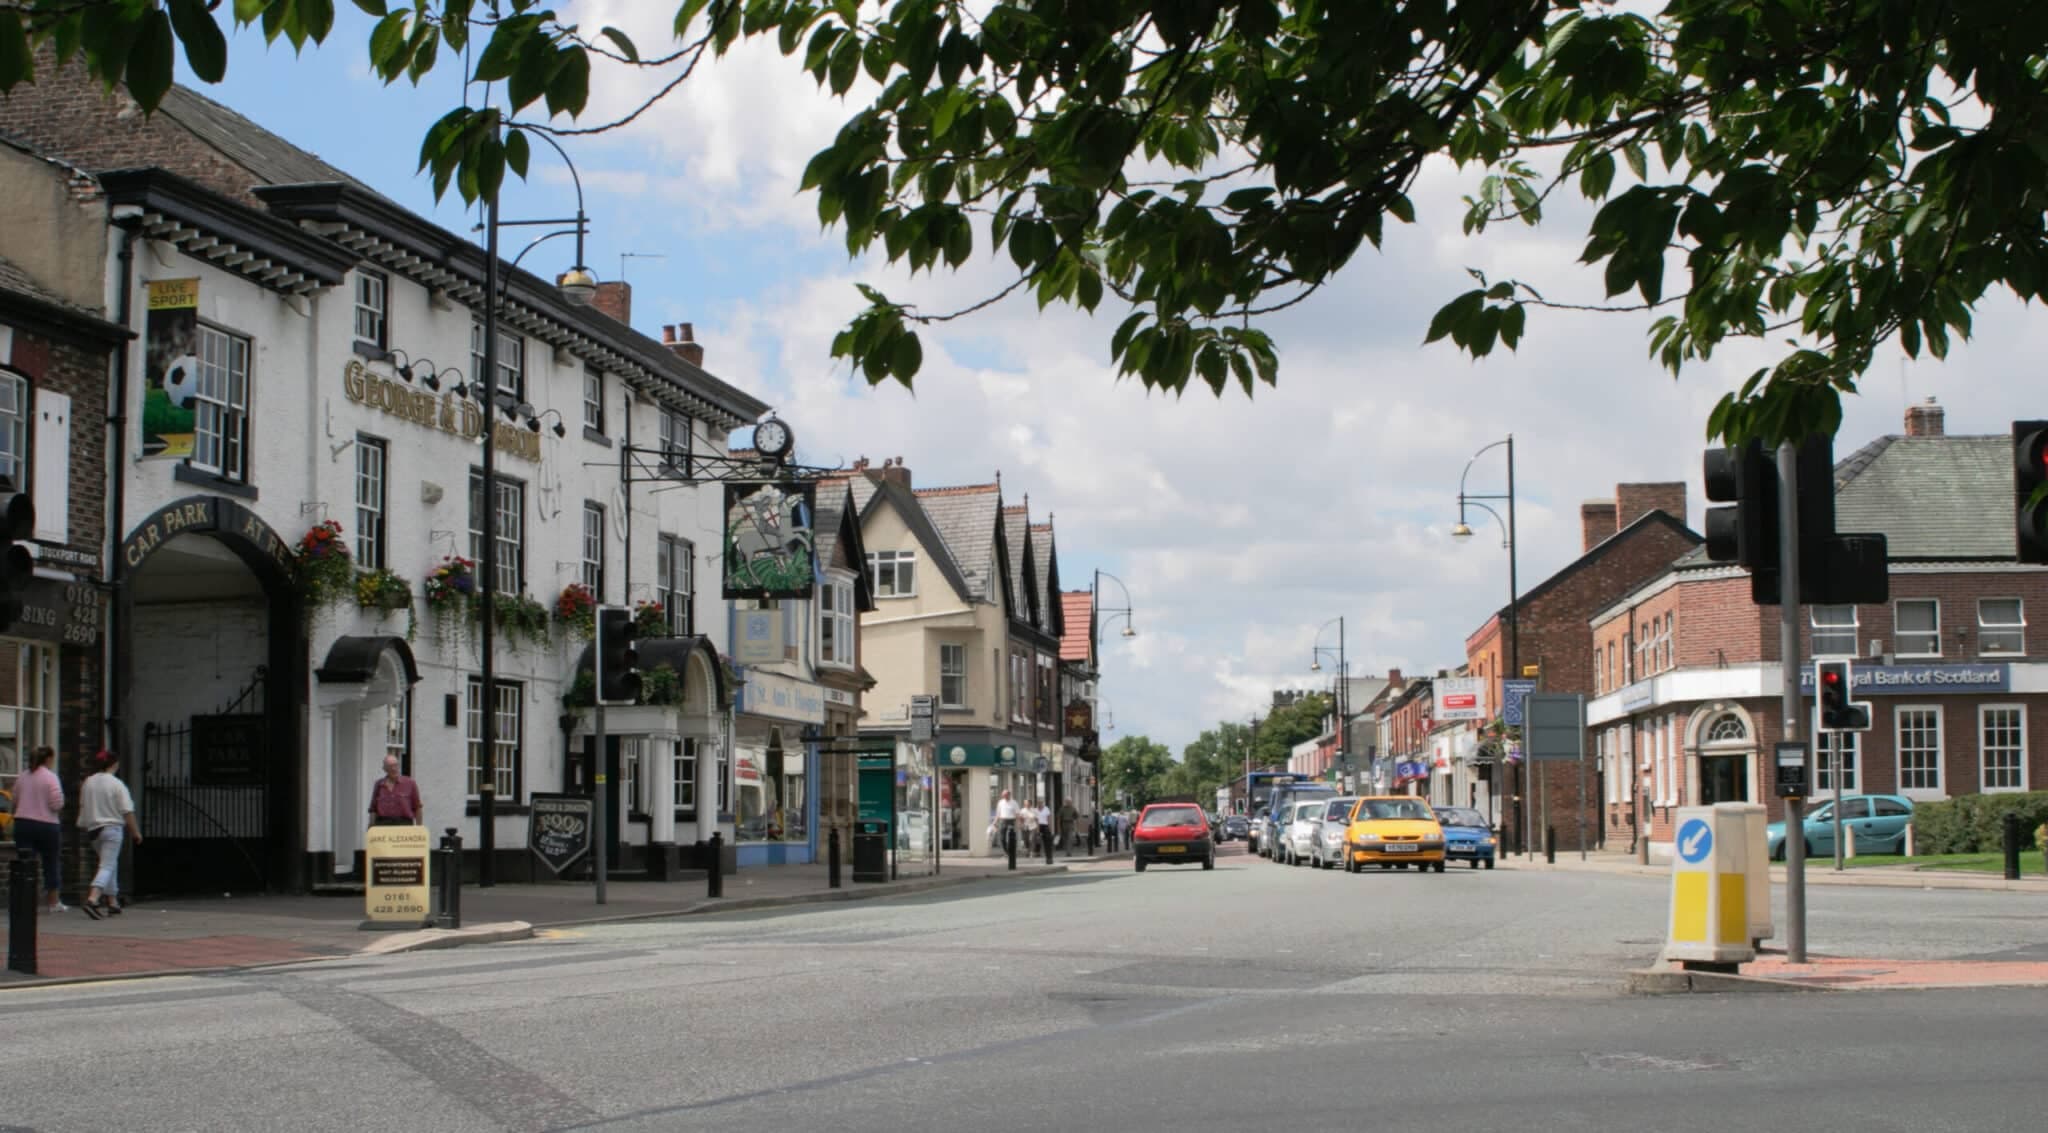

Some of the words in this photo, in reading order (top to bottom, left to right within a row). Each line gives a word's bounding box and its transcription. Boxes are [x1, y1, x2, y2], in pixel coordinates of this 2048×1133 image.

[159, 281, 187, 294] LIVE
[151, 294, 194, 306] SPORT
[344, 359, 436, 426] GEORGE
[440, 395, 457, 435] &
[462, 399, 541, 464] DAGON
[126, 523, 161, 567] CAR
[163, 503, 209, 534] PARK
[243, 516, 264, 545] AT
[39, 546, 77, 561] STOCKPORT
[79, 552, 97, 566] ROAD
[66, 585, 98, 606] 0161
[73, 606, 97, 625] 428
[63, 623, 97, 644] 2690
[1875, 670, 1914, 685] Bank
[1916, 669, 1931, 684] of
[1933, 669, 2001, 684] Scotland
[384, 893, 410, 901] 0161
